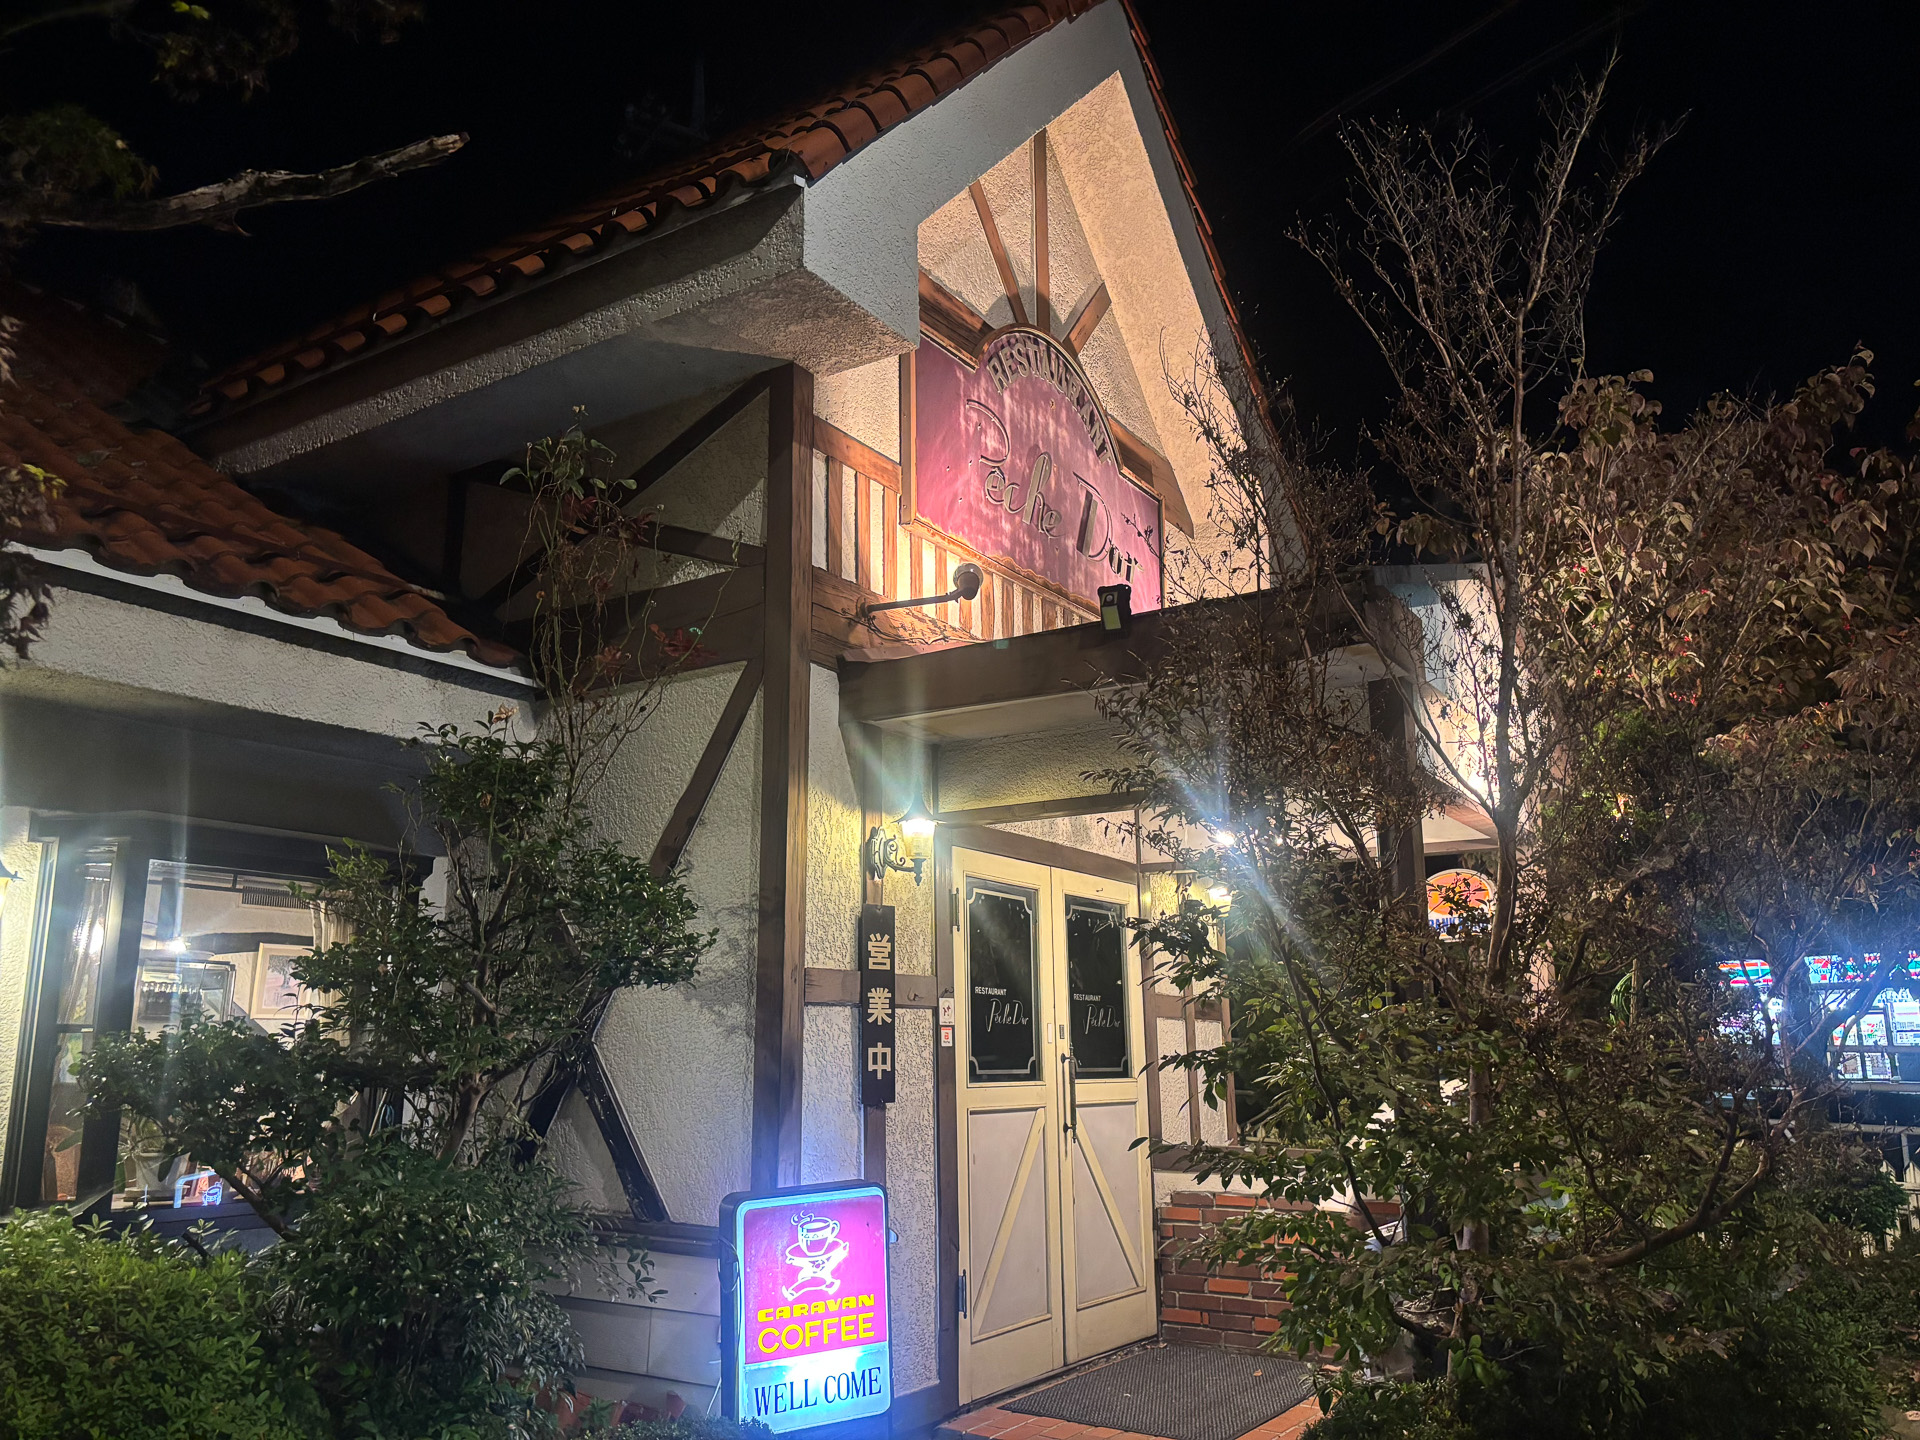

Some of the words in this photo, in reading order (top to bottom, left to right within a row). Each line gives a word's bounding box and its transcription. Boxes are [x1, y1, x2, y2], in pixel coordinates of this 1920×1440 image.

[986, 341, 1113, 465] RESTAURANT
[867, 932, 892, 1080] 営業中
[974, 986, 1007, 996] RESTAURANT
[1073, 993, 1102, 1002] RESTAURANT
[757, 1293, 875, 1323] CARAVAN
[757, 1312, 875, 1354] COFFEE
[754, 1378, 818, 1417] WELL
[824, 1366, 882, 1404] COME
